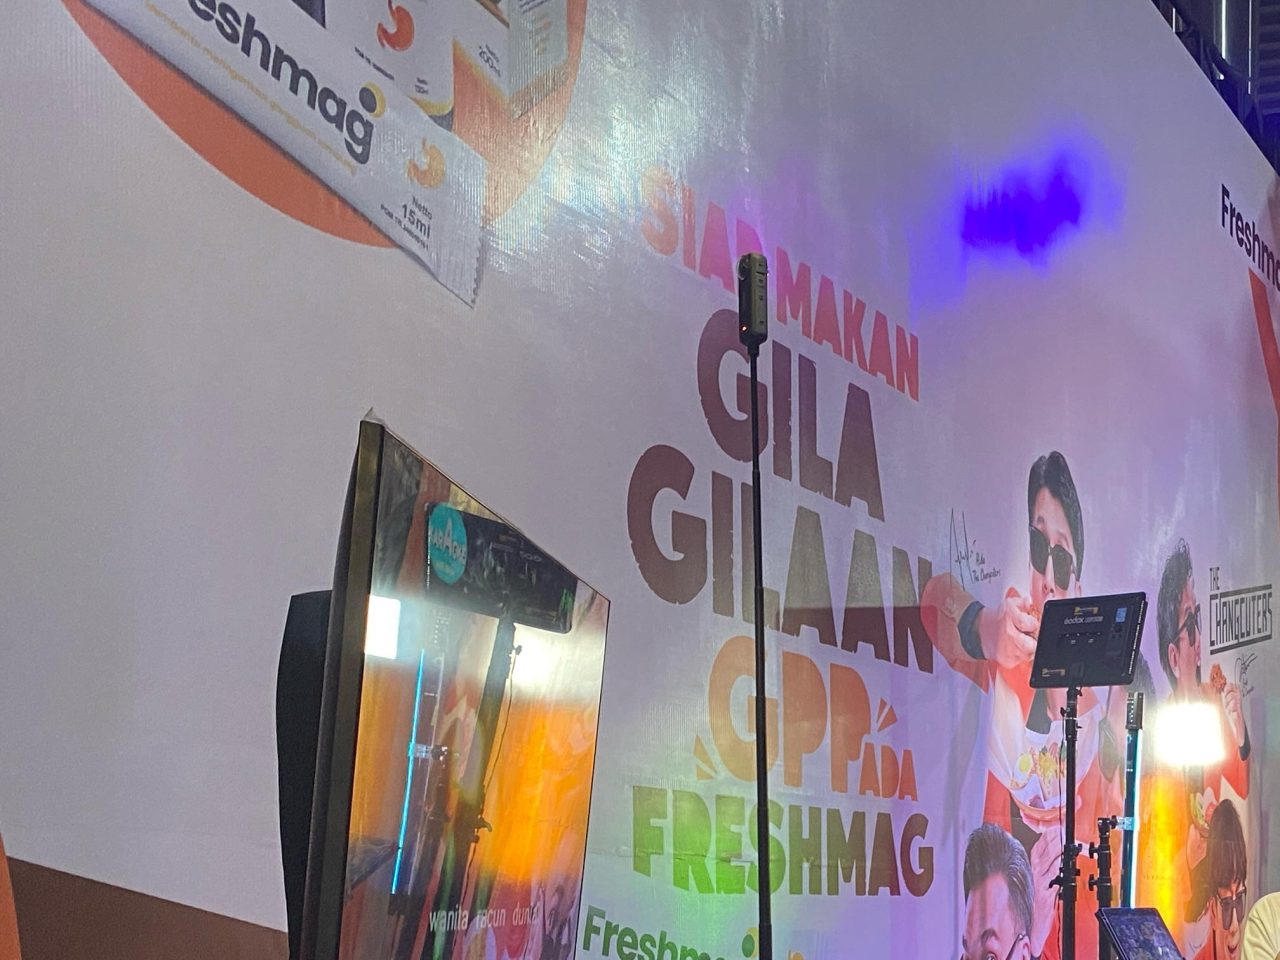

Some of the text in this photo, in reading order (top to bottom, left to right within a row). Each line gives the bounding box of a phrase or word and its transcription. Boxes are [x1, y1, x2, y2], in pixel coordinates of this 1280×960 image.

[402, 204, 430, 239] 15ml
[776, 246, 919, 403] MAKAN
[697, 309, 885, 522] GILA
[627, 445, 933, 674] GILAAN
[709, 635, 918, 801] GPP ADA
[475, 908, 506, 930] racun
[632, 785, 934, 897] FRESHMAG
